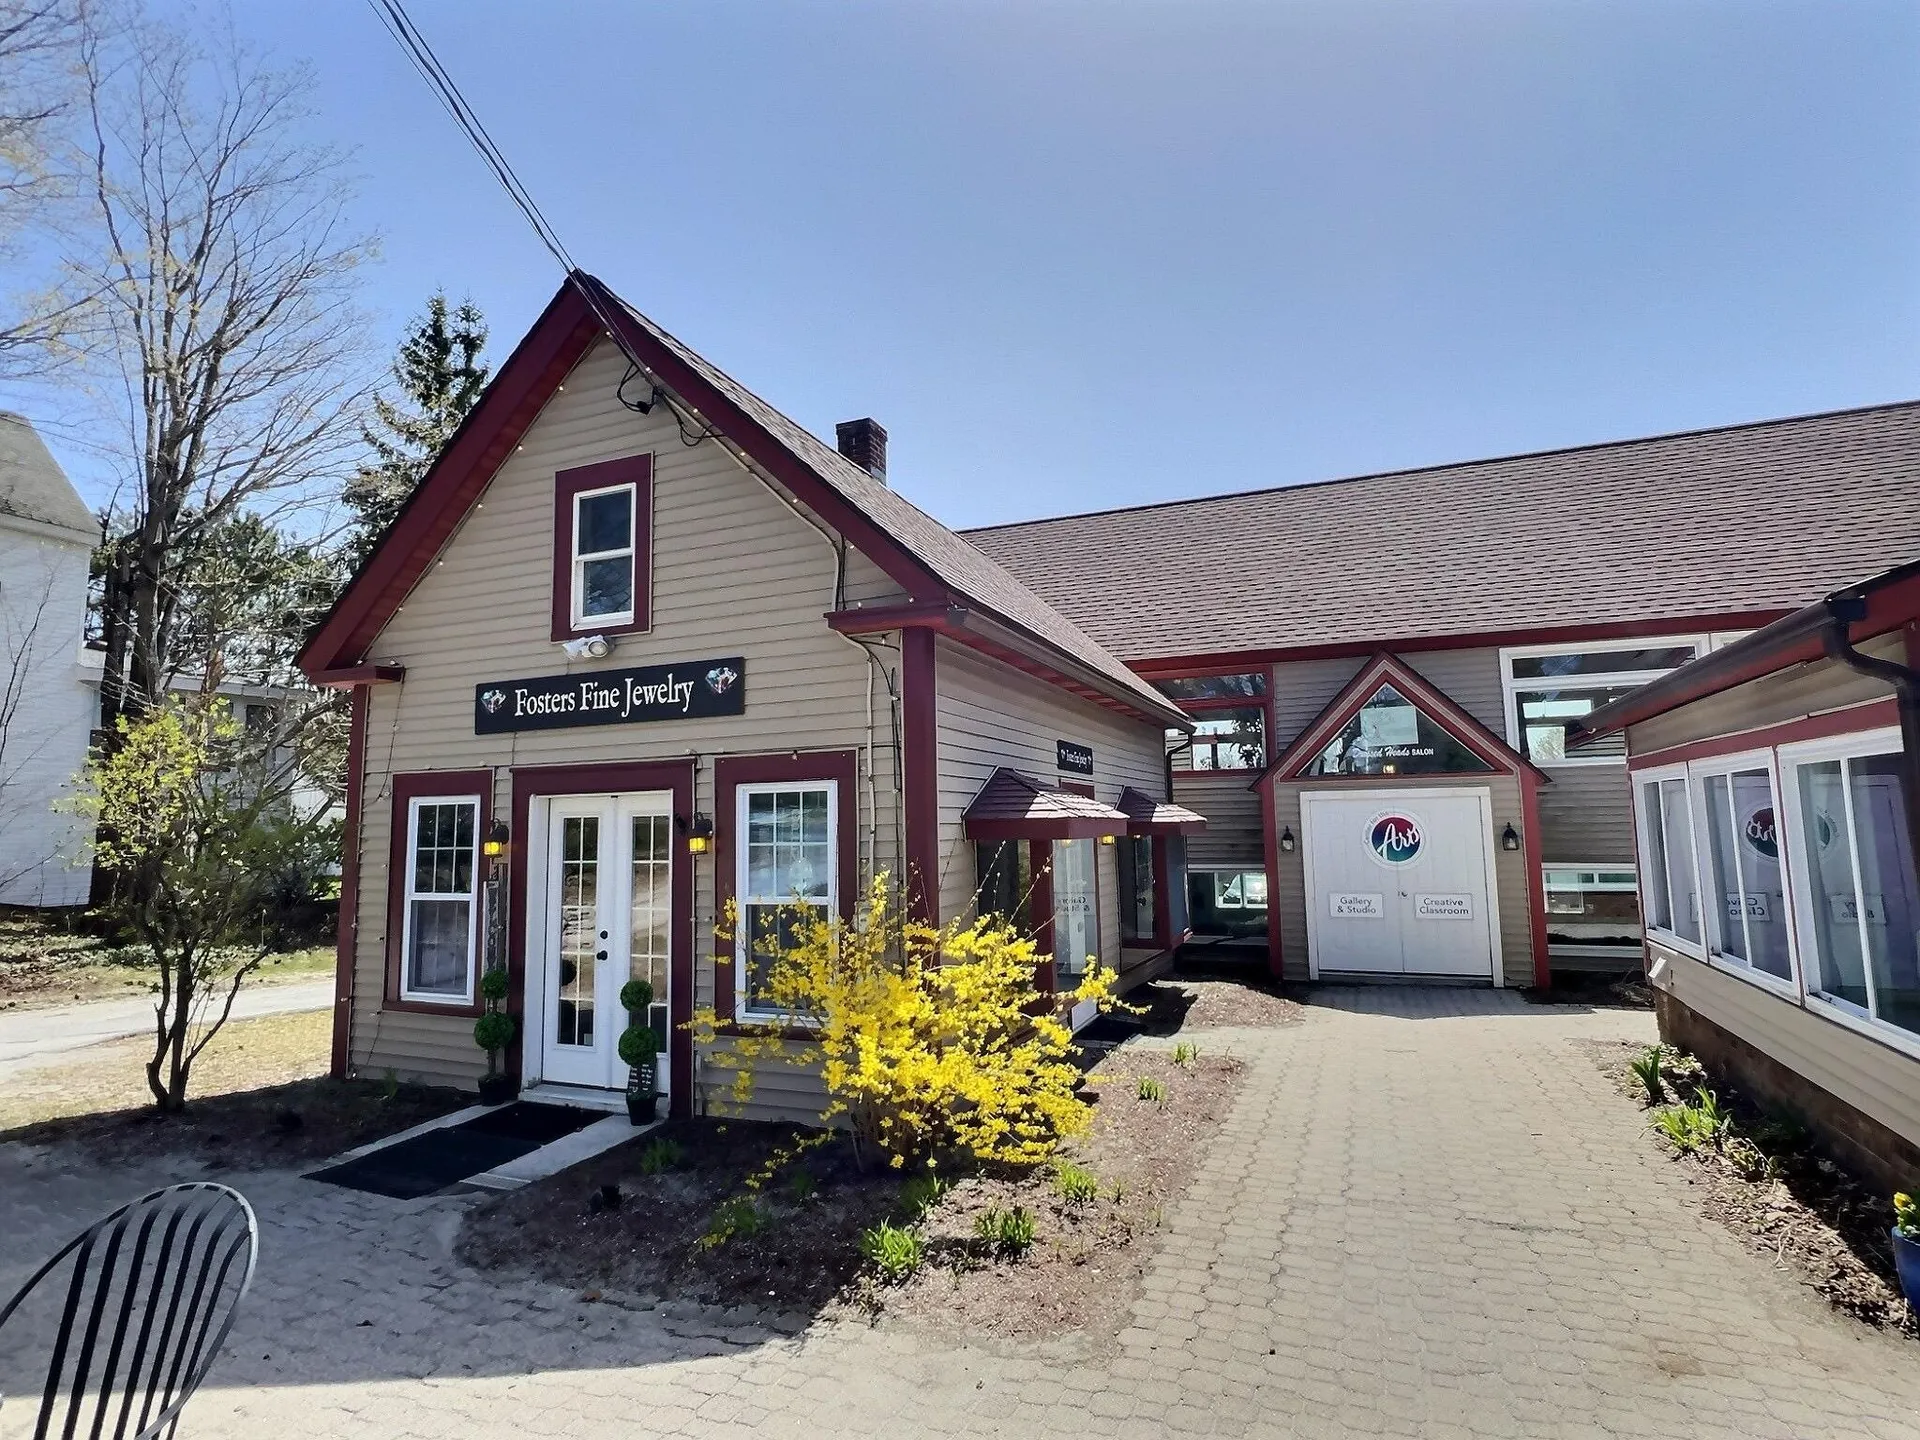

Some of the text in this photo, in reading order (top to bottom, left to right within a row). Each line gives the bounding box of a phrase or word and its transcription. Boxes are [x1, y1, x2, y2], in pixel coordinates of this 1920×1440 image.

[514, 673, 694, 717] Fosters Fine Jewelry
[1411, 748, 1434, 756] SALON
[1377, 823, 1420, 860] Arts
[1339, 896, 1372, 907] Gallery
[1423, 897, 1464, 906] Creative
[1337, 905, 1377, 914] & Studio
[1419, 906, 1469, 915] Classroom
